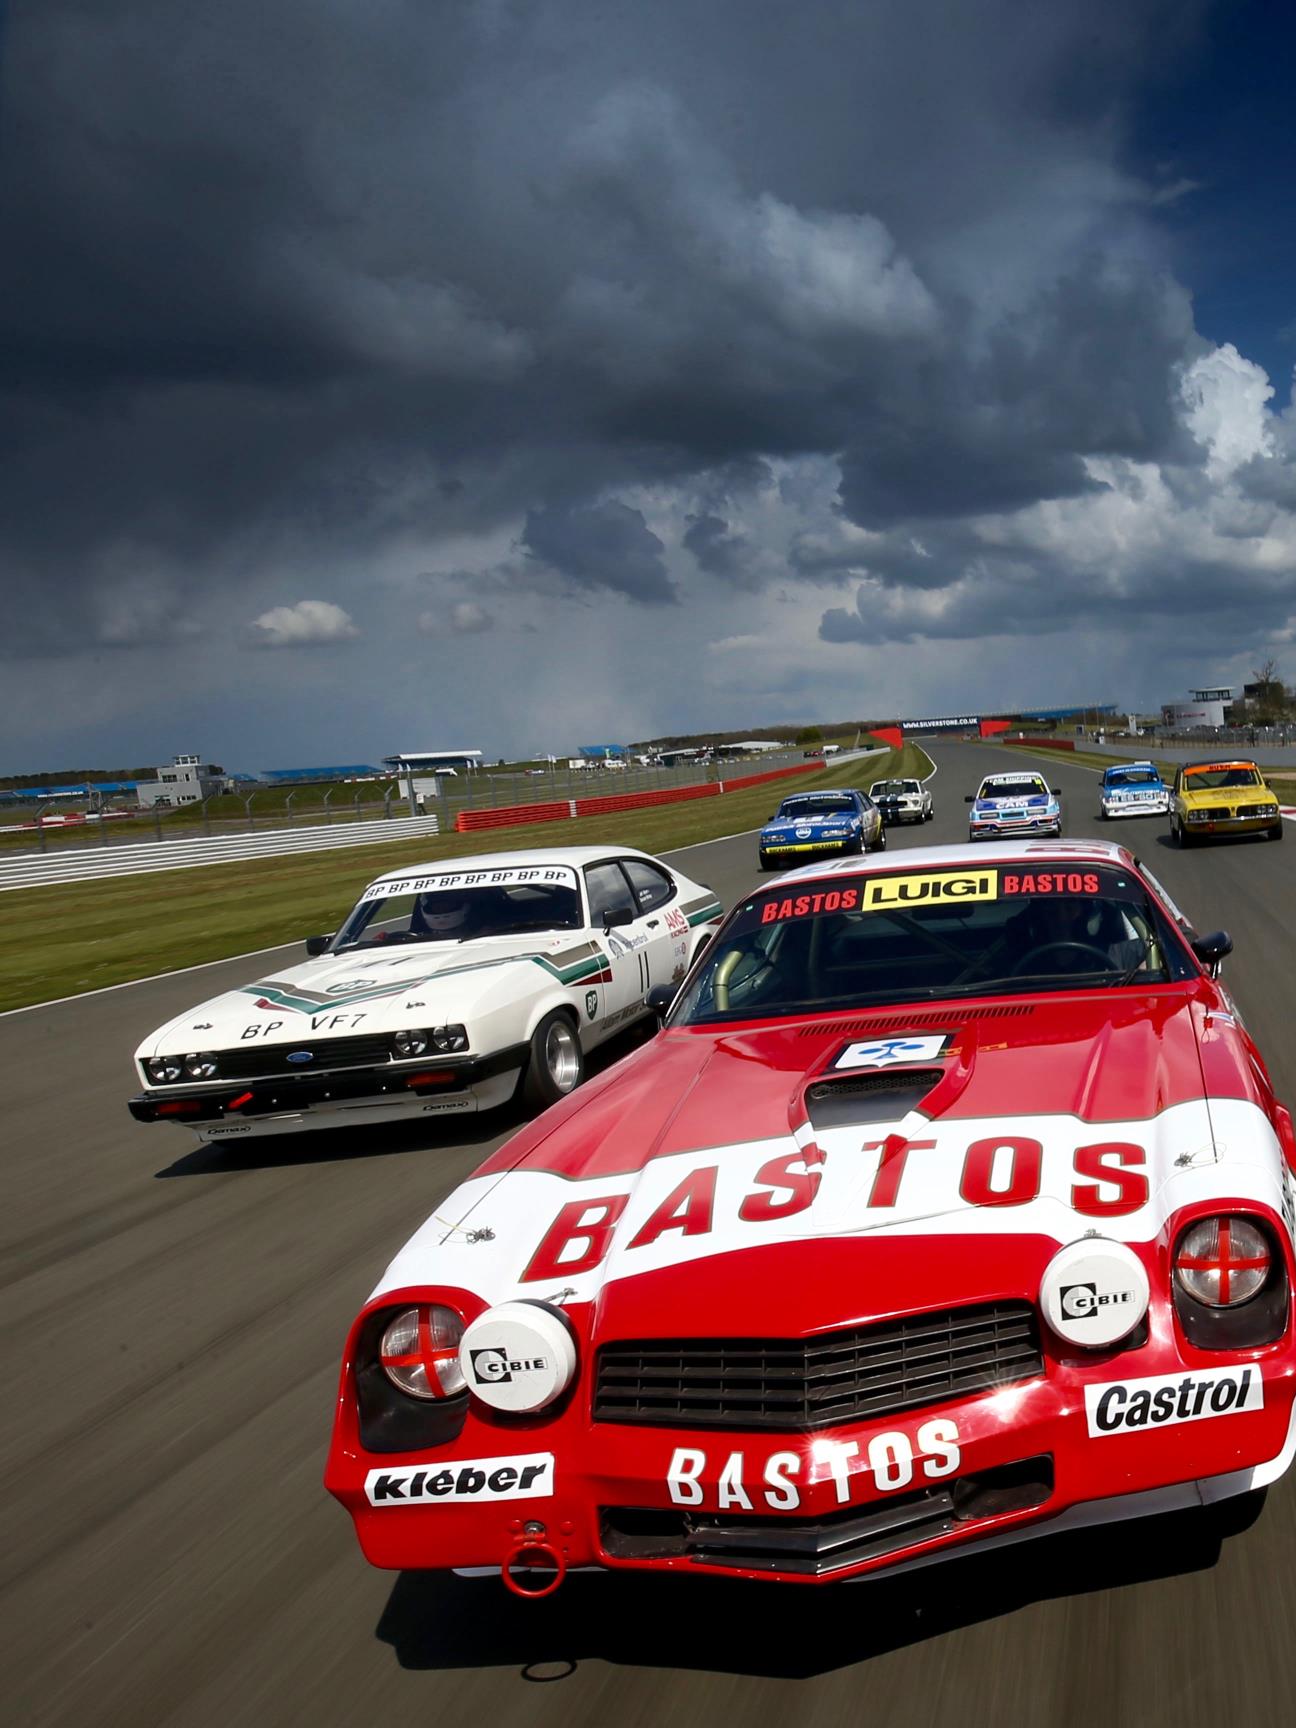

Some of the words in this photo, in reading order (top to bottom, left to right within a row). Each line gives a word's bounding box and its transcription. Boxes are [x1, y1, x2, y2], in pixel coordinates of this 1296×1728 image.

[902, 718, 978, 729] WWW.SILVERSTONE.CO.UK
[996, 801, 1029, 809] CAM
[366, 887, 385, 897] BP
[389, 883, 409, 893] BP
[414, 880, 434, 890] BP
[439, 877, 460, 887] BP
[465, 875, 486, 884] BP
[491, 873, 512, 882] BP
[517, 871, 539, 880] BP
[544, 871, 566, 880] BP
[871, 878, 990, 904] LUIGI
[1003, 873, 1099, 894] BASTOS
[762, 889, 857, 923] BASTOS
[664, 908, 685, 930] AMS
[587, 995, 597, 1012] BP
[240, 1021, 284, 1040] BP
[310, 1013, 368, 1031] VF7
[518, 1134, 1151, 1284] BASTOS
[1075, 1292, 1131, 1308] CIBIE
[487, 1359, 545, 1372] CIBIE
[1096, 1369, 1252, 1431] Castrol
[666, 1418, 961, 1510] BASTOS
